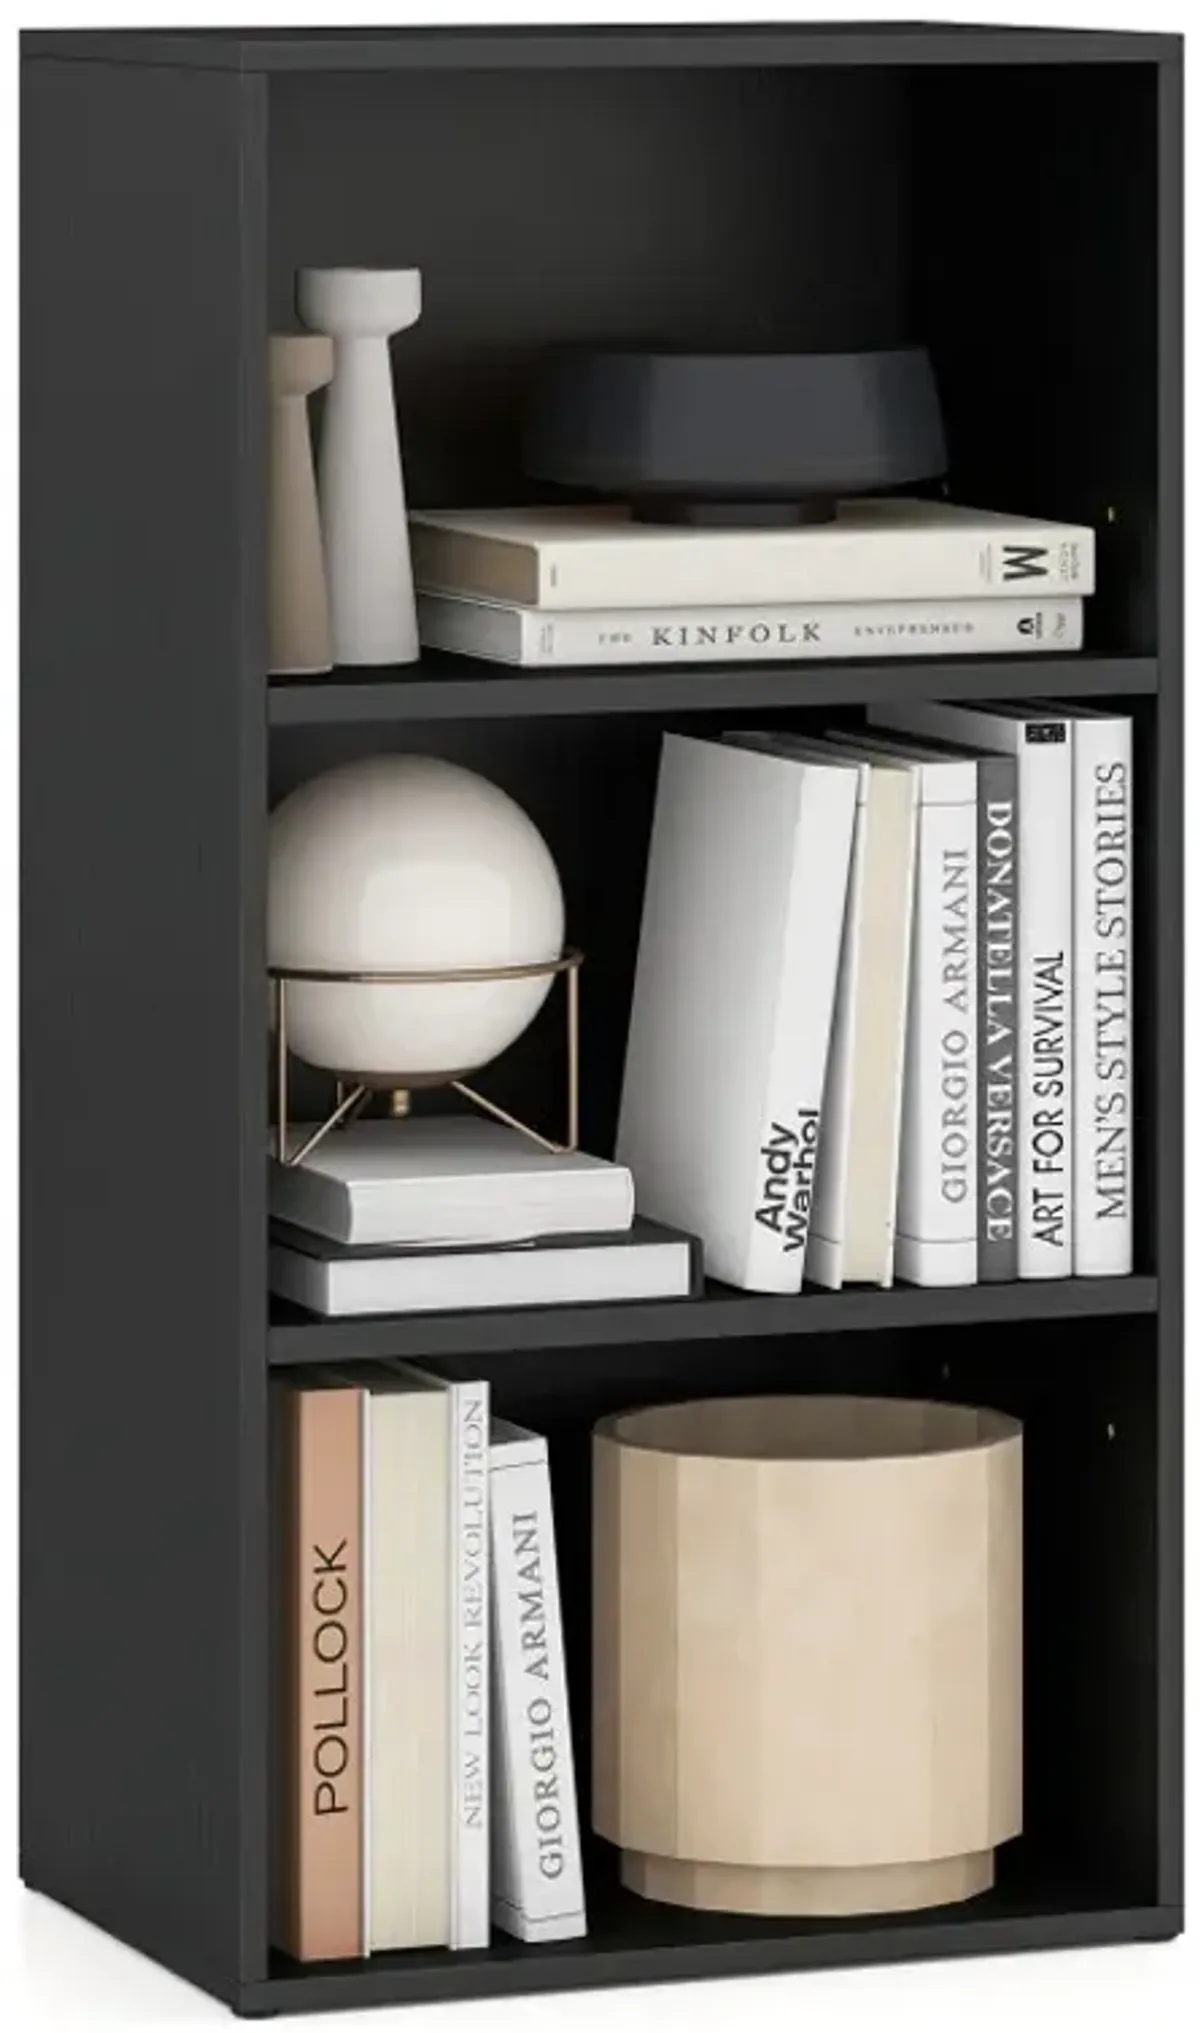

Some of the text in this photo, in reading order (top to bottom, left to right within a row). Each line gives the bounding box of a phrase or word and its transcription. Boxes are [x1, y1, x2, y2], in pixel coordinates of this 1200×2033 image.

[652, 622, 821, 646] KINFOLK
[1002, 545, 1049, 581] M
[941, 849, 969, 1203] GIORGIO ARMANI
[987, 802, 1013, 1241] DONATELLA VERSACE
[1032, 950, 1064, 1247] ART FOR SURVIVAL
[1094, 762, 1128, 1219] MEN'S STYLE STORIES
[755, 1121, 799, 1233] Andy
[783, 1109, 819, 1252] Warhol
[313, 1539, 349, 1816] POLLOCK
[464, 1400, 483, 1830] NEW LOOK REVOLUTION
[512, 1510, 564, 1880] GIORGIO ARMANI
